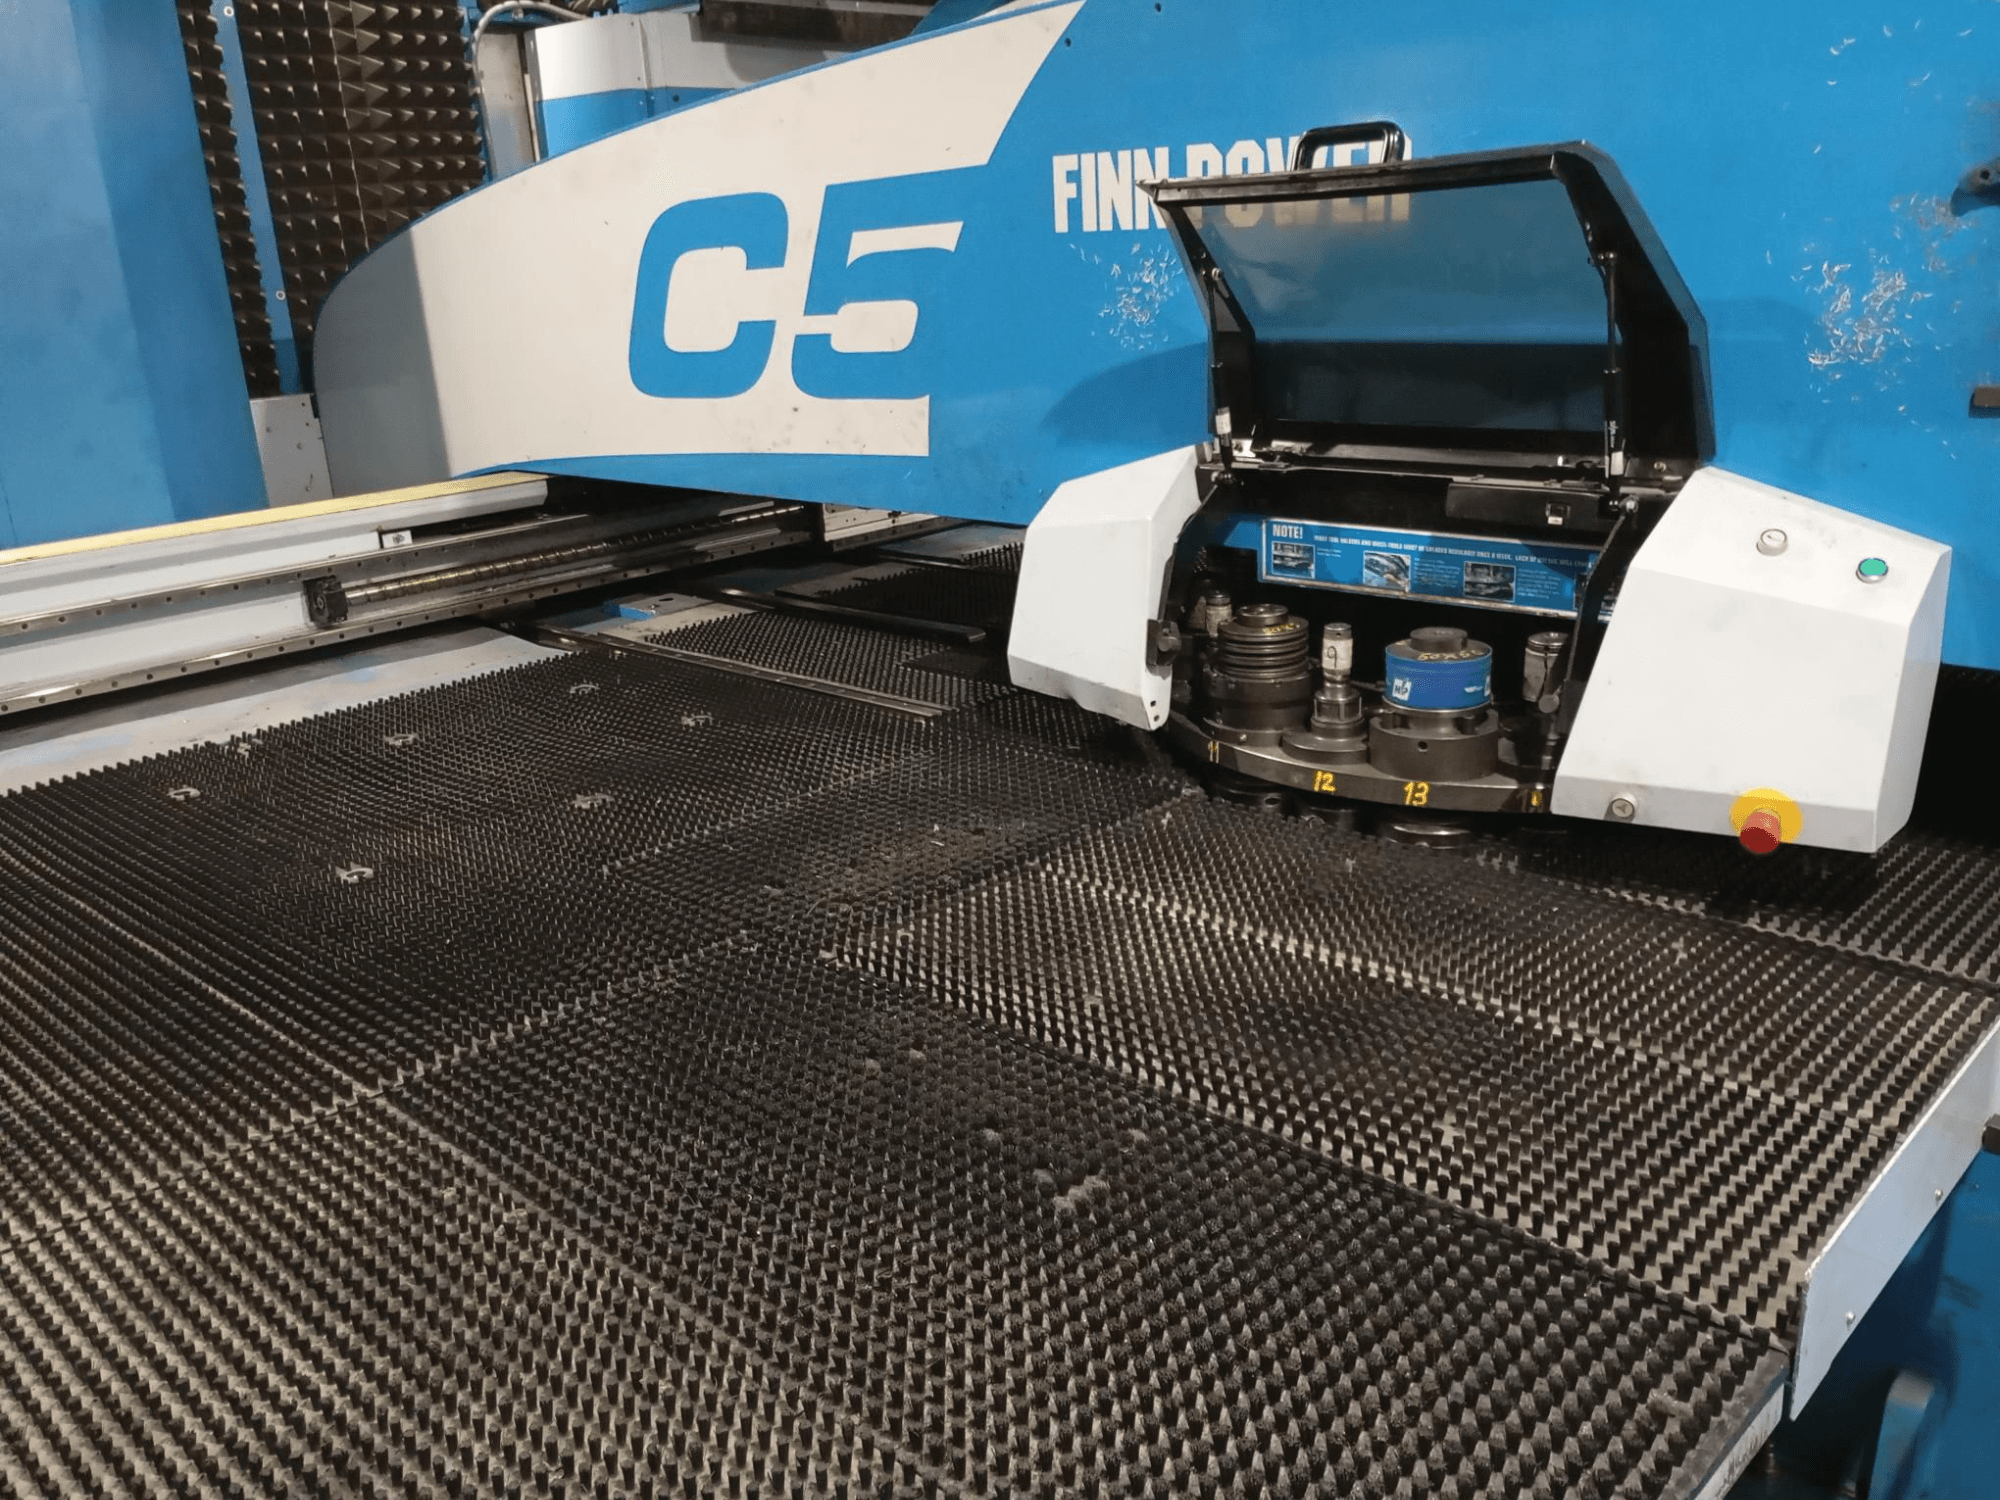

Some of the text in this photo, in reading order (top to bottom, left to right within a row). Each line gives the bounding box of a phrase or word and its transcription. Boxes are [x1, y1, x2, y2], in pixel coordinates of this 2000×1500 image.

[1052, 146, 1170, 233] FINN
[628, 173, 966, 400] C5
[1272, 523, 1303, 540] NOTE!
[1313, 770, 1337, 792] 12
[1402, 780, 1430, 806] 13
